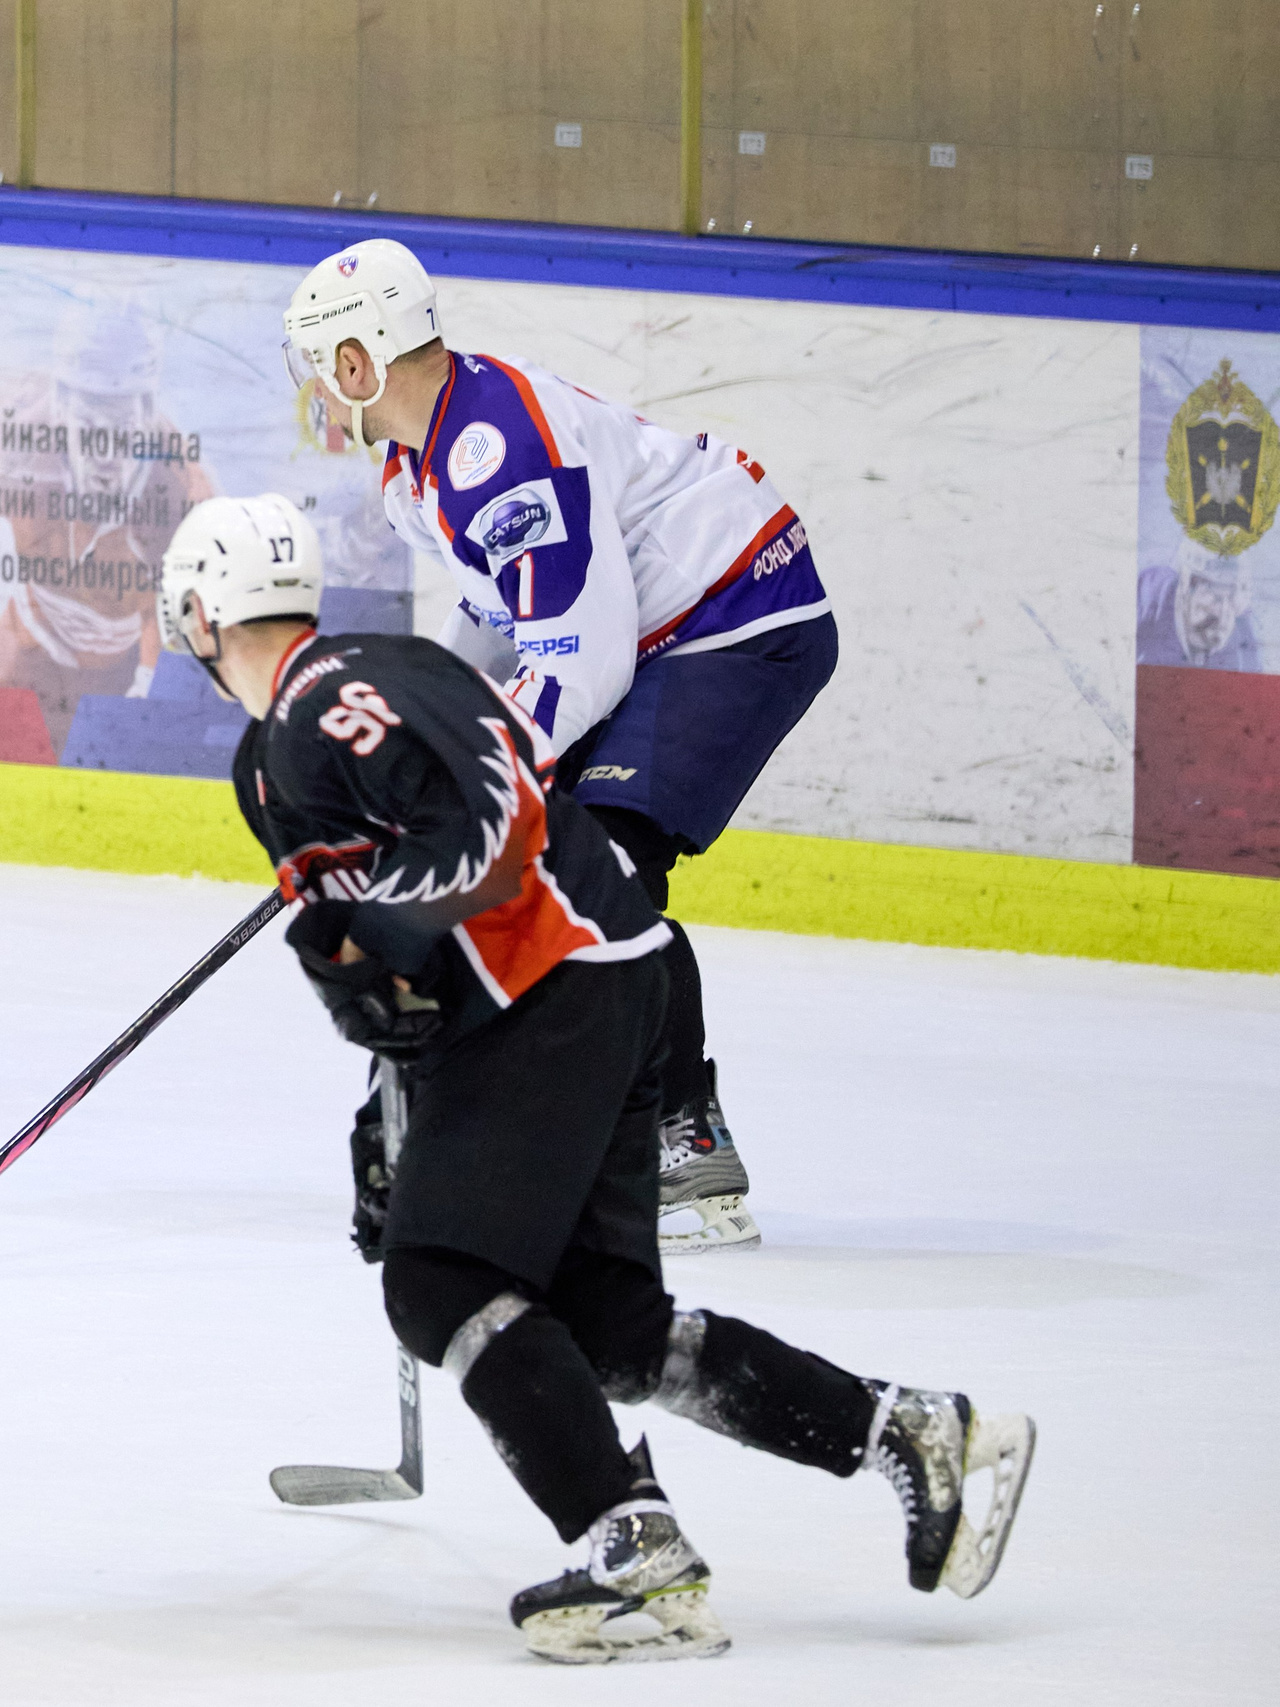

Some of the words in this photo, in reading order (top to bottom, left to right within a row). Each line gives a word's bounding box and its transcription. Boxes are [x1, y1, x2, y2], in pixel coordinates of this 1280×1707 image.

[425, 307, 435, 332] 7
[79, 424, 200, 468] команда
[47, 484, 168, 527] военный
[488, 506, 542, 544] DATSUN
[268, 537, 294, 563] 17
[577, 765, 638, 785] CCM
[239, 898, 281, 943] BAUER
